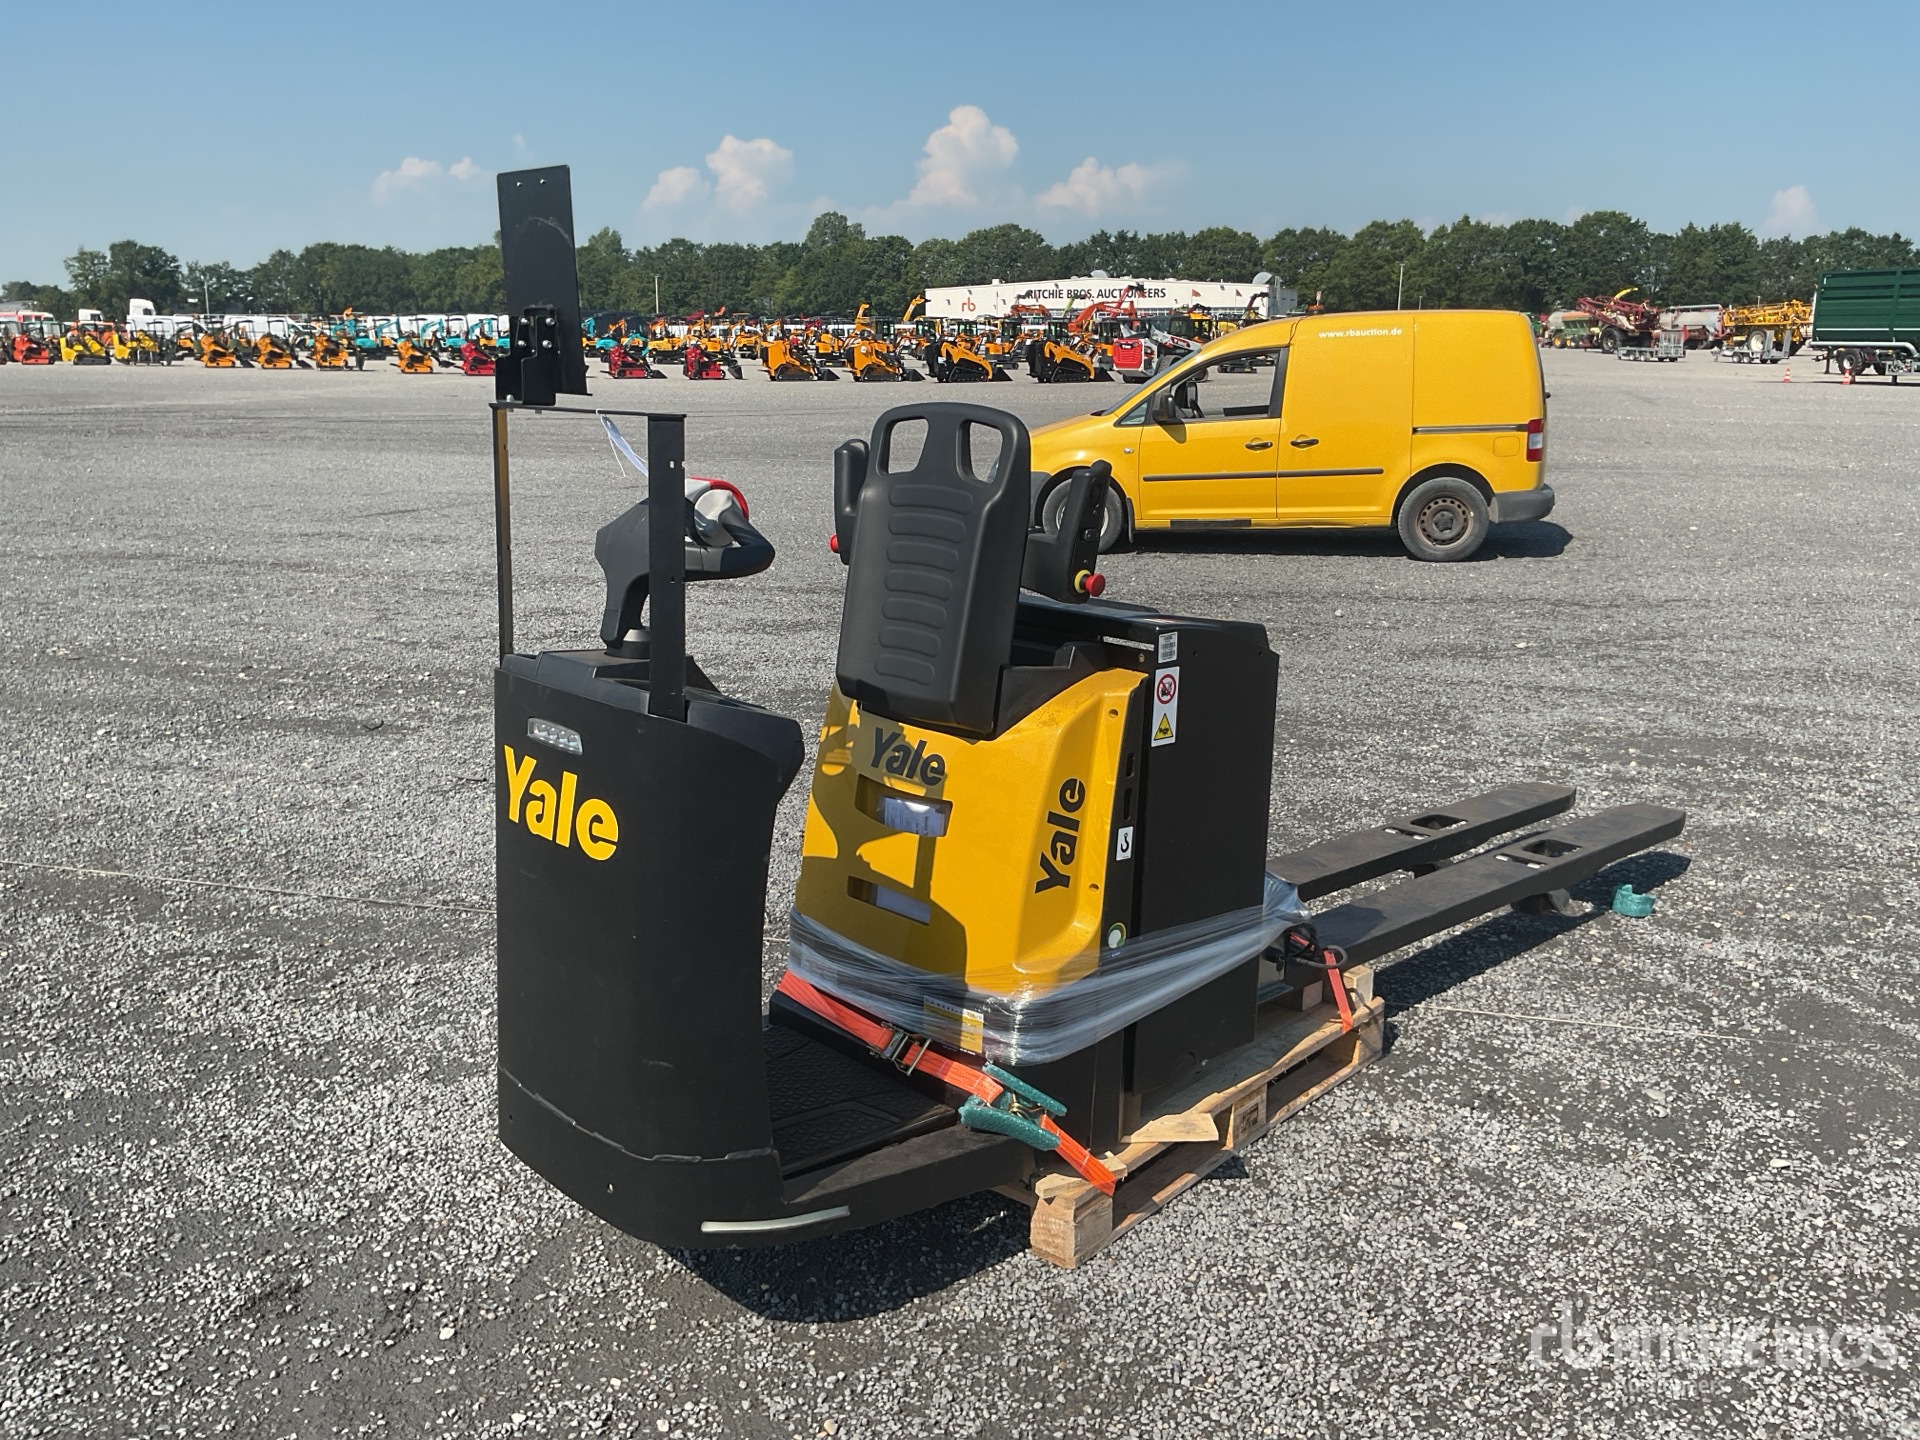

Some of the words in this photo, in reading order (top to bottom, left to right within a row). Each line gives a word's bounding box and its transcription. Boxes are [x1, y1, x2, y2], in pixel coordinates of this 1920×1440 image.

[961, 297, 976, 312] rb
[1318, 327, 1402, 339] www.rbauction.de
[870, 726, 947, 786] Yale
[504, 744, 619, 861] Yale
[1034, 777, 1086, 894] Yale
